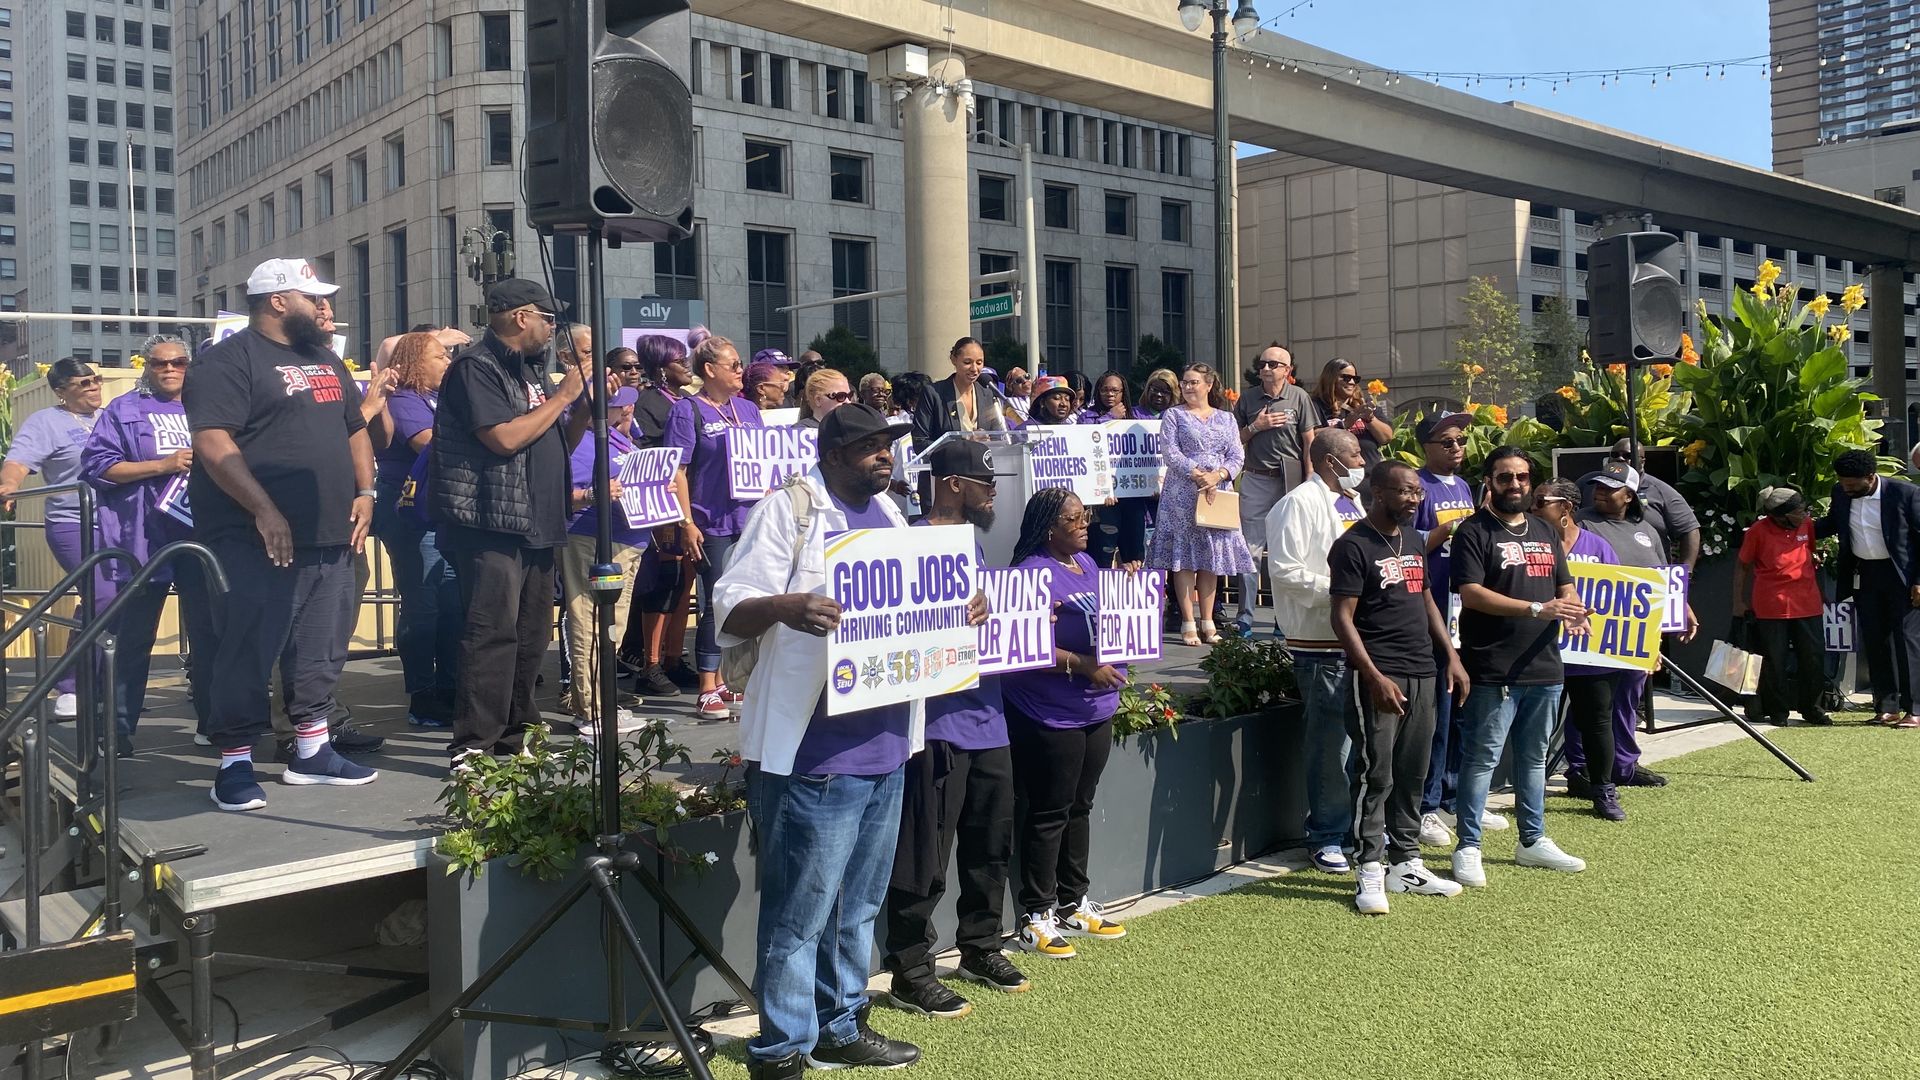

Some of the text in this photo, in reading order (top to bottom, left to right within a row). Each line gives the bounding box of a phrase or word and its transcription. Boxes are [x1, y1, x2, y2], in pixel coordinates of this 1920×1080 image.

[640, 302, 671, 321] ally
[160, 430, 190, 447] FOR
[729, 428, 816, 459] UNIONS
[1032, 437, 1069, 457] ARENA
[1107, 433, 1137, 455] GOOD
[620, 450, 678, 484] UNIONS
[736, 461, 762, 487] FOR
[1033, 457, 1088, 478] WORKERS
[1131, 474, 1147, 490] 58
[645, 484, 679, 521] ALL
[1338, 511, 1363, 521] OCAL
[1435, 500, 1469, 511] LOCAL
[834, 553, 970, 613] GOOD JOBS
[1099, 570, 1161, 611] UNIONS
[834, 613, 891, 645] THRIVING
[978, 618, 1001, 656] OR
[1007, 617, 1050, 665] ALL
[1101, 613, 1122, 648] FOR
[1126, 613, 1157, 656] ALL
[1599, 618, 1650, 658] ALL
[887, 648, 921, 687] 58
[836, 679, 853, 689] SEIU
